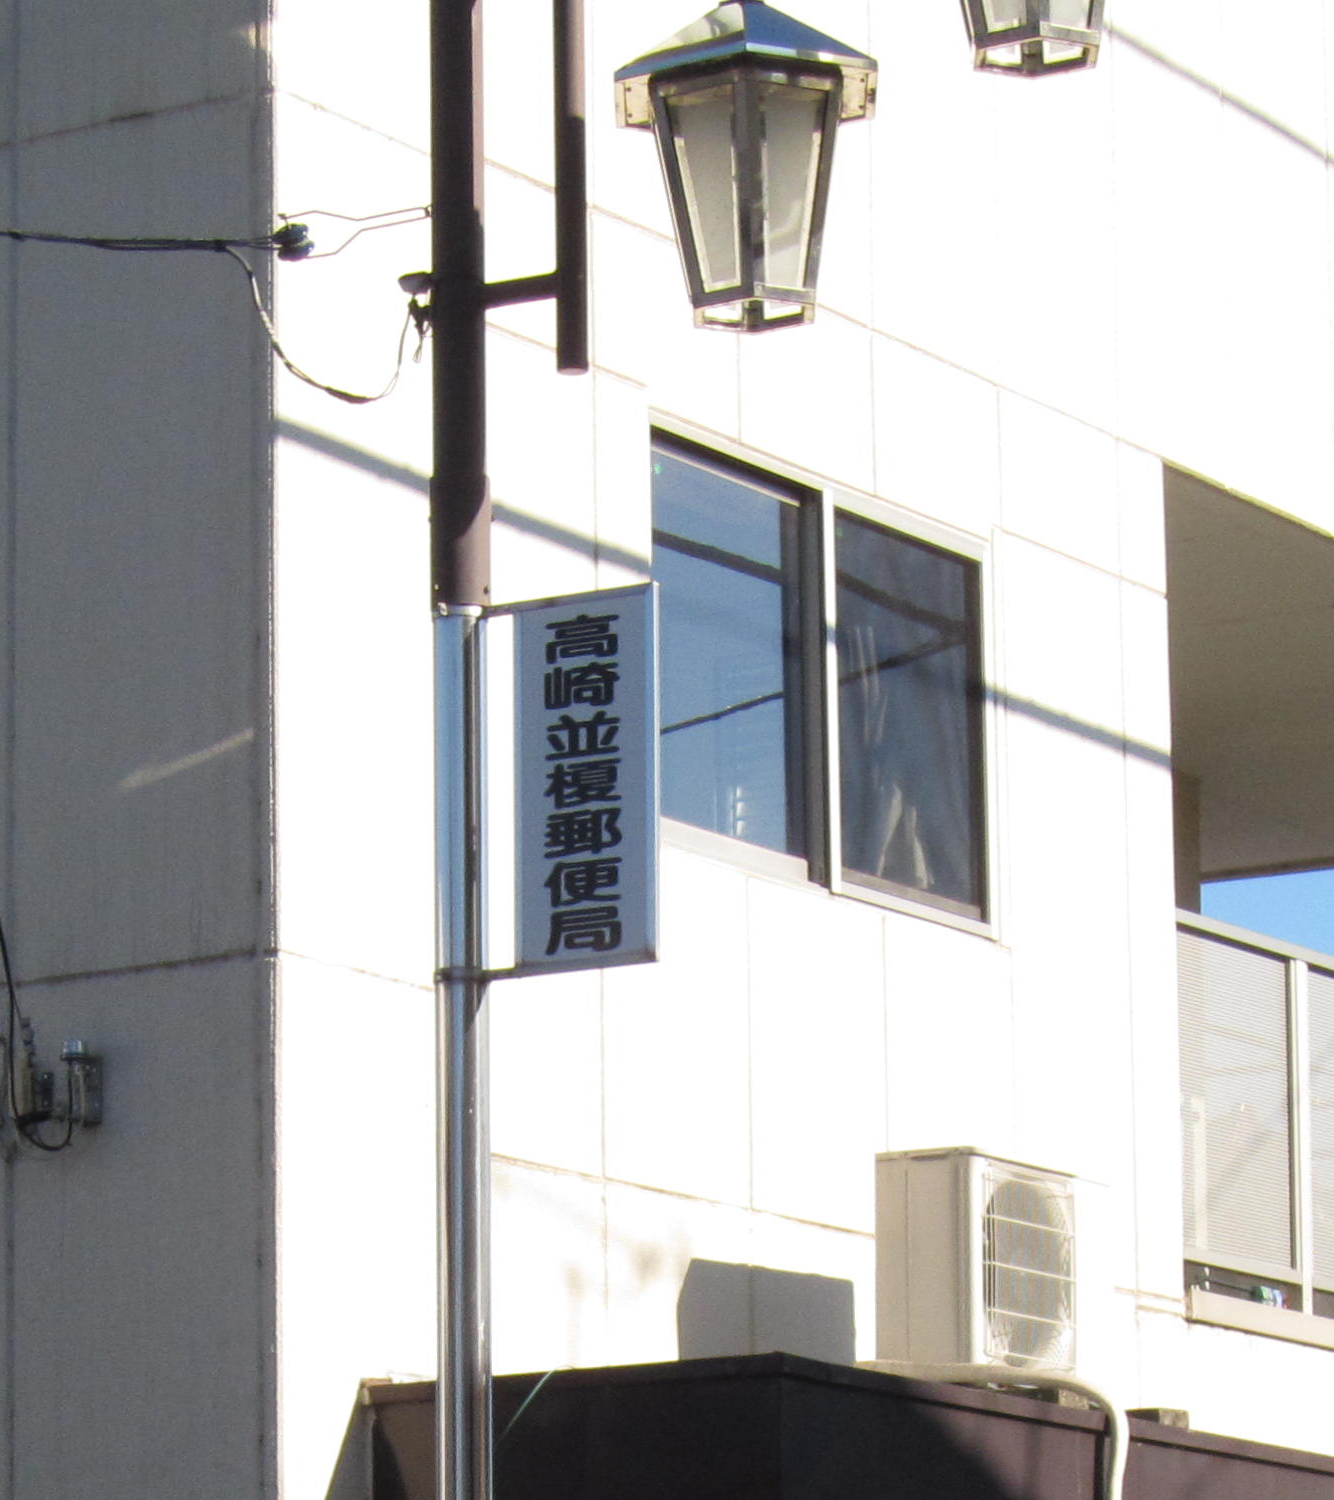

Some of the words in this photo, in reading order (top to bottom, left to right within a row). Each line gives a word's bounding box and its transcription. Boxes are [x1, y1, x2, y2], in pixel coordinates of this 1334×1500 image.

[543, 613, 622, 956] 高崎並榎郵便局
